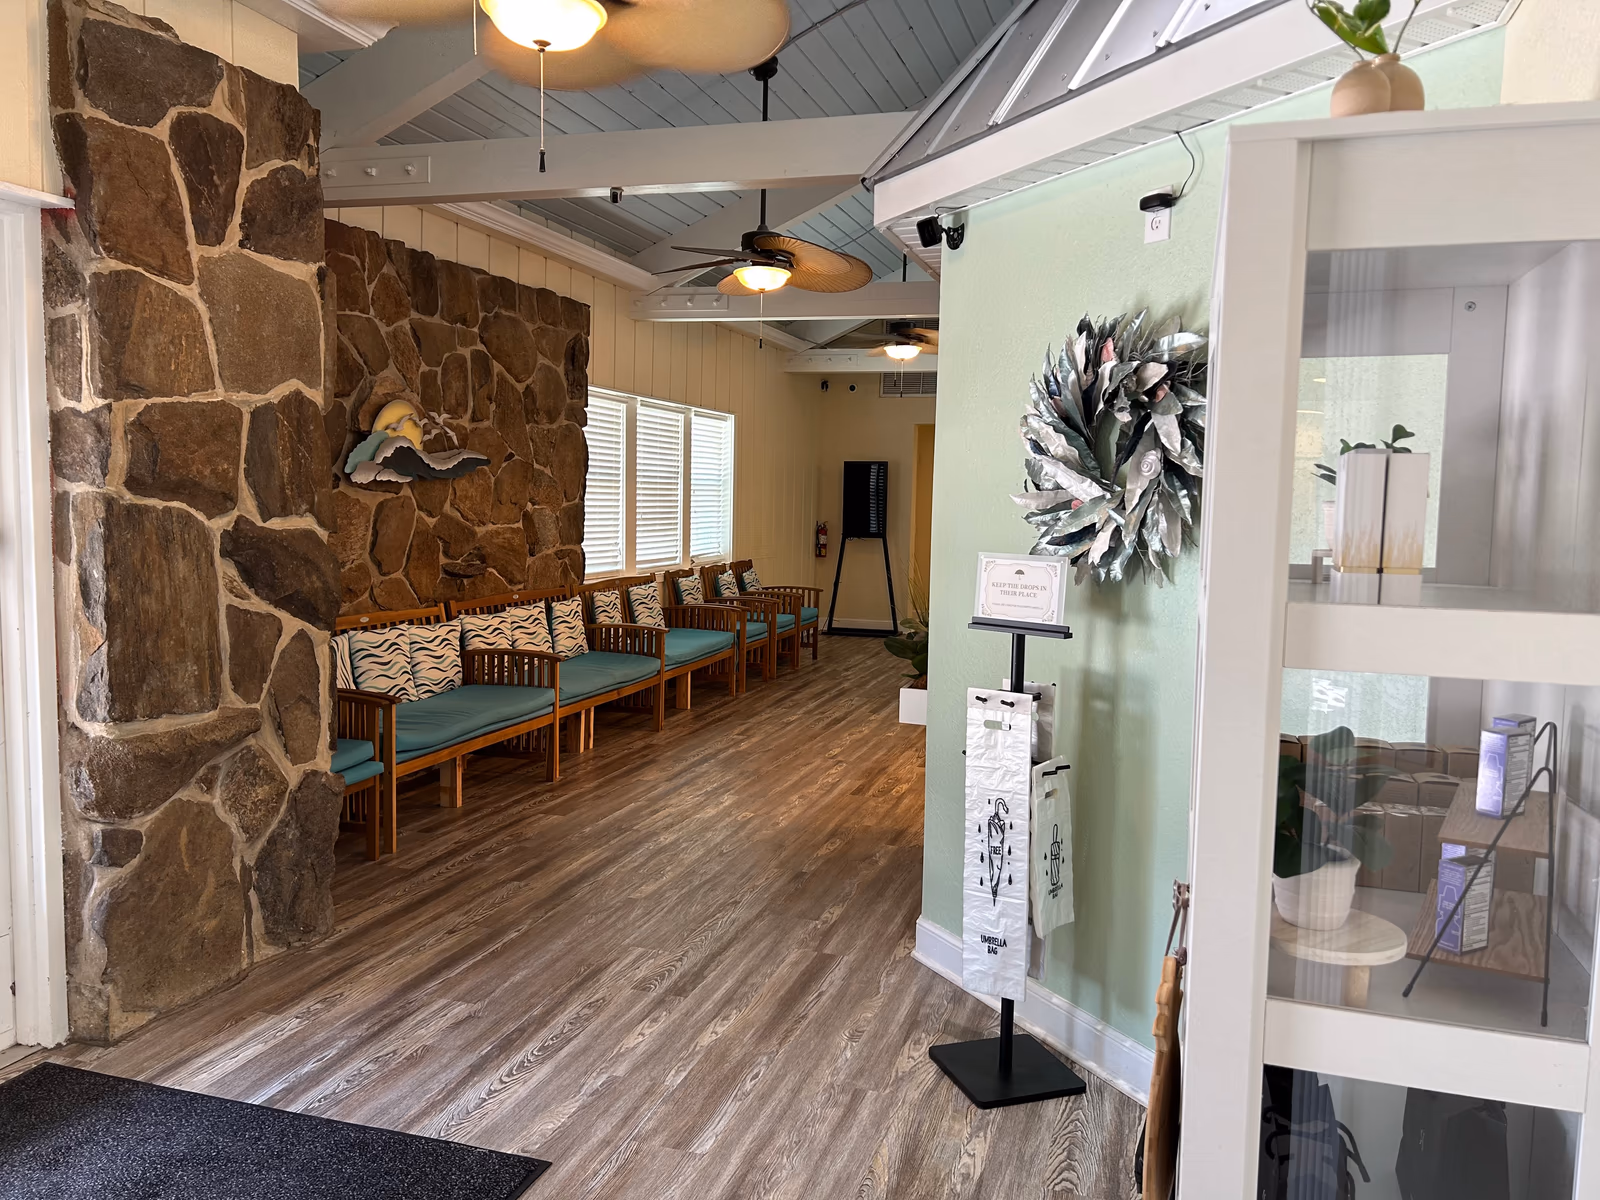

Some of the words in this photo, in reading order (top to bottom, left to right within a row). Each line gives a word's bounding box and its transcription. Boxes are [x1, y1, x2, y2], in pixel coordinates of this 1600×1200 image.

[990, 845, 1001, 855] FREE
[980, 934, 1007, 948] UMBRELLA
[987, 945, 998, 955] BAG
